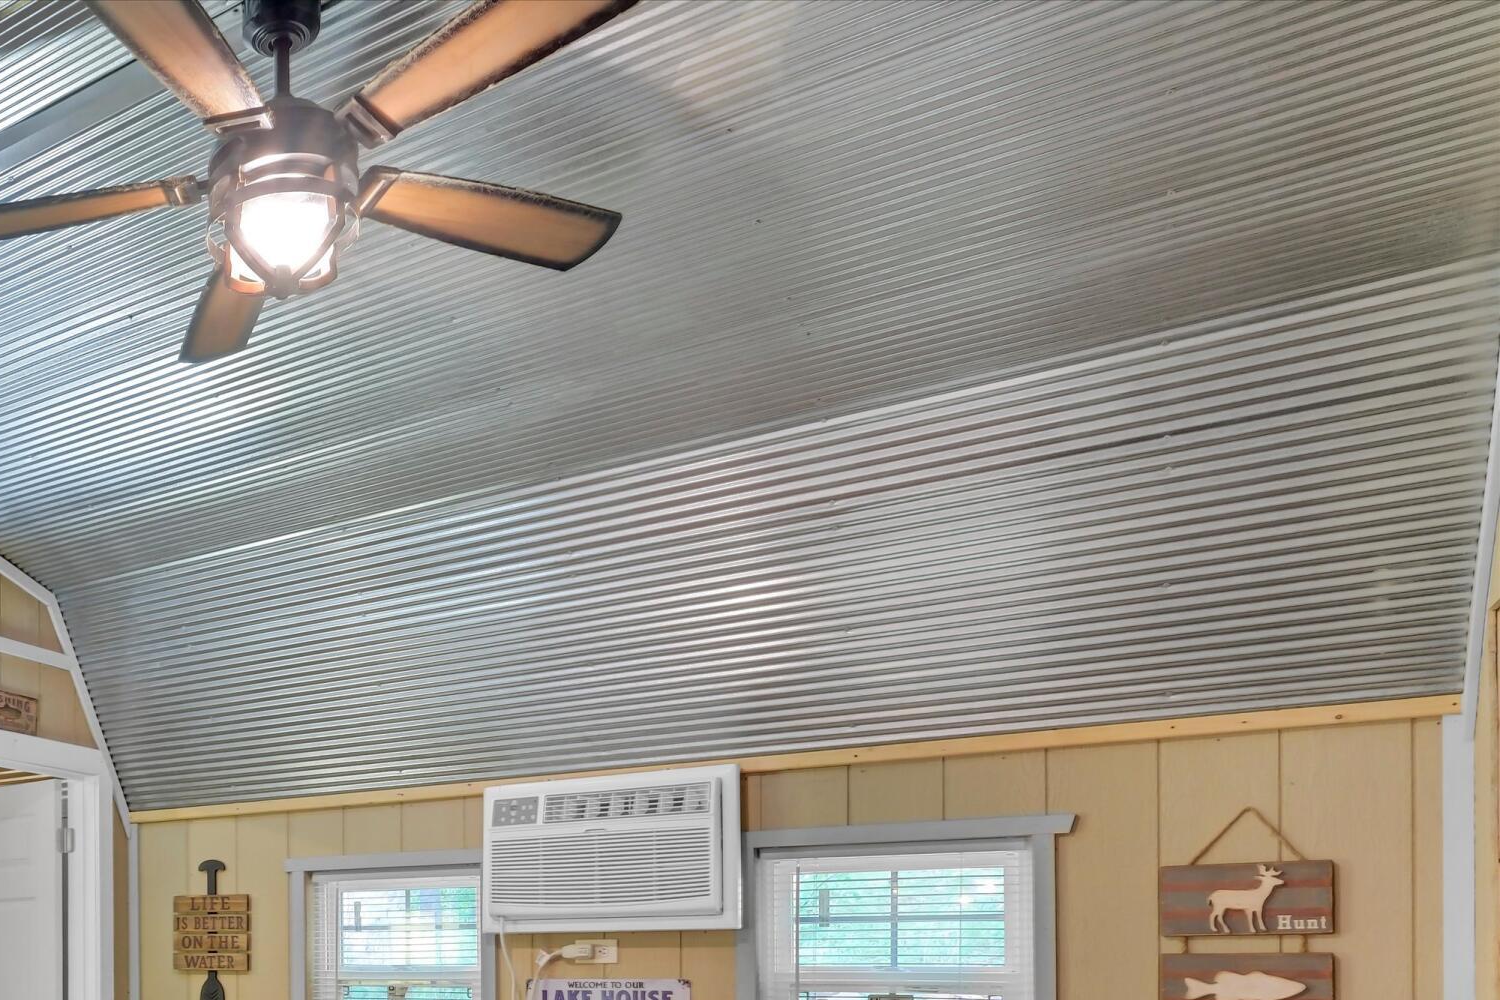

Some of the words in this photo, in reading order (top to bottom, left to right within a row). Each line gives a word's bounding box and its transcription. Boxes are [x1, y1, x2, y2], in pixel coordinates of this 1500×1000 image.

[191, 897, 230, 910] LIFE
[176, 917, 188, 930] IS
[194, 916, 244, 930] BETTER
[1276, 914, 1328, 930] Hunt
[182, 936, 203, 949] ON
[208, 936, 240, 949] THE
[184, 955, 234, 968] WATER
[567, 981, 608, 989] WELCOME
[610, 981, 622, 989] TO
[625, 981, 644, 989] OUR
